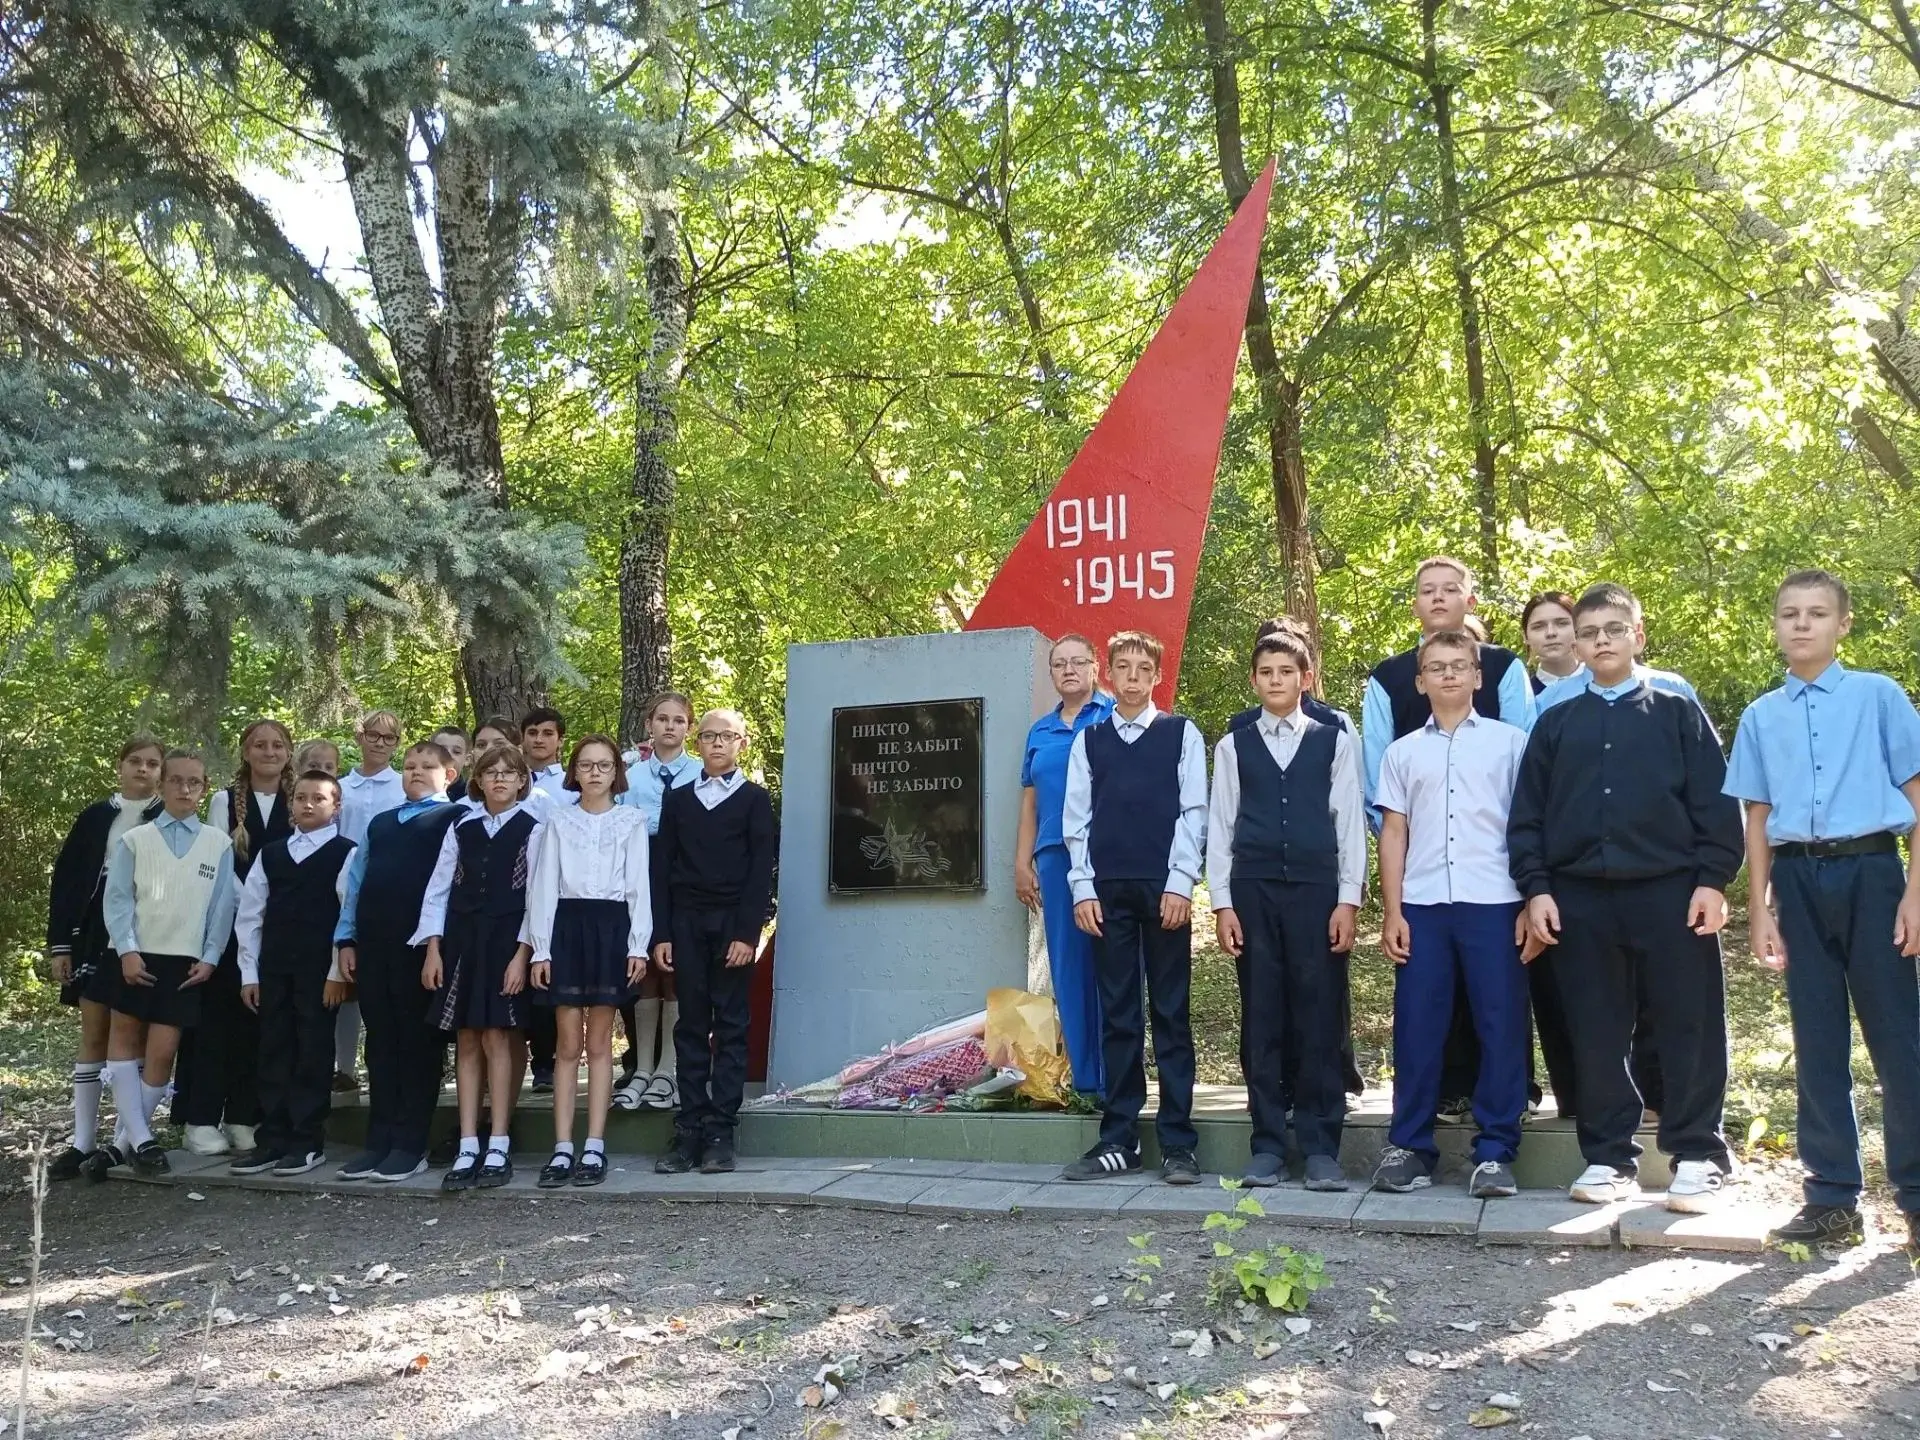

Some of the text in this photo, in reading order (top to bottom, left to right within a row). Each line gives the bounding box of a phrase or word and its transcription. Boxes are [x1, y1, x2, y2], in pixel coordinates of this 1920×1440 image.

[1046, 494, 1127, 549] 1941
[852, 722, 910, 738] НИКТО
[878, 741, 900, 755] НЕ
[851, 760, 910, 776] НИЧТО
[867, 776, 963, 794] НЕ ЗАБЫТО
